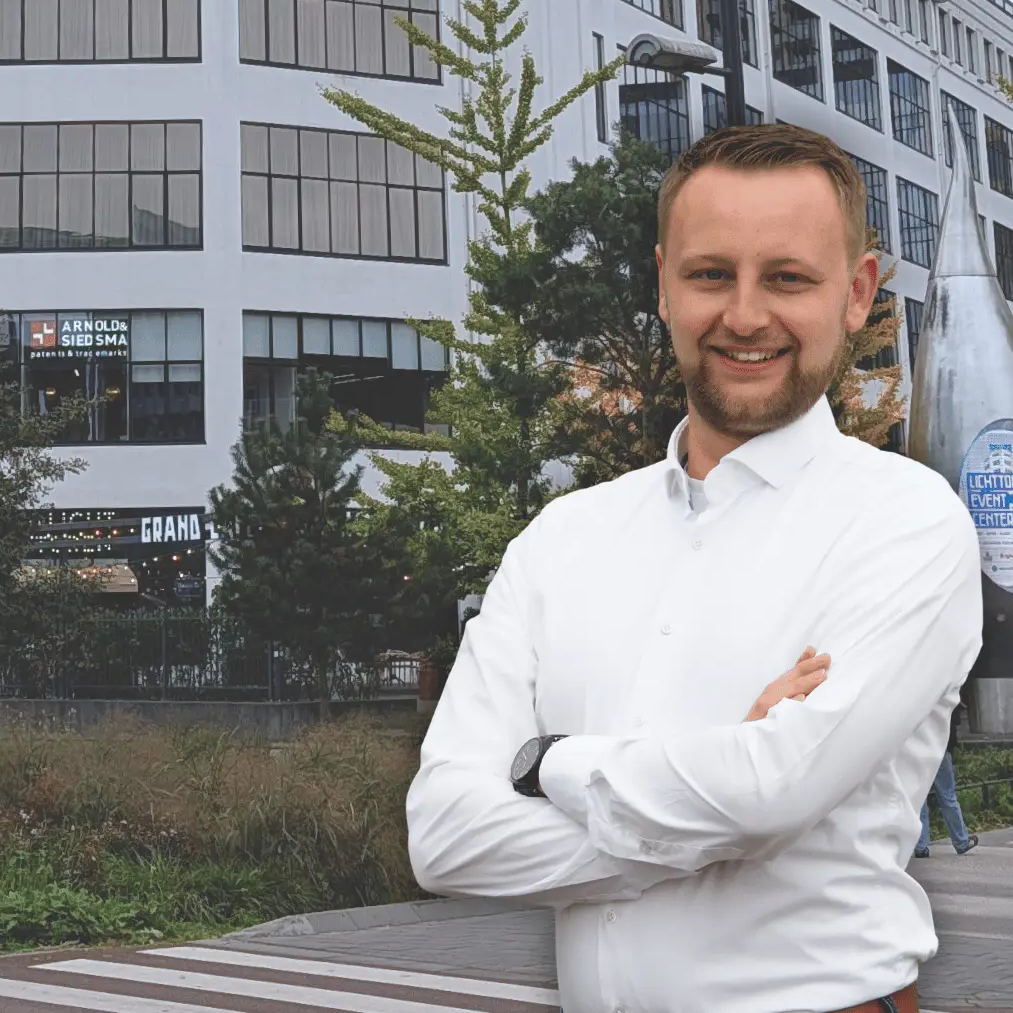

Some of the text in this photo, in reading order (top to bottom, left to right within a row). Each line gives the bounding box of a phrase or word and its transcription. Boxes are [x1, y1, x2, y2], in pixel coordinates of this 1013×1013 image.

[61, 320, 128, 332] ARNOLD&
[61, 334, 128, 347] SIEDSMA
[30, 350, 65, 359] patents
[969, 474, 1013, 489] LICHTTO
[971, 493, 1007, 508] EVENT
[141, 514, 201, 542] GRAND
